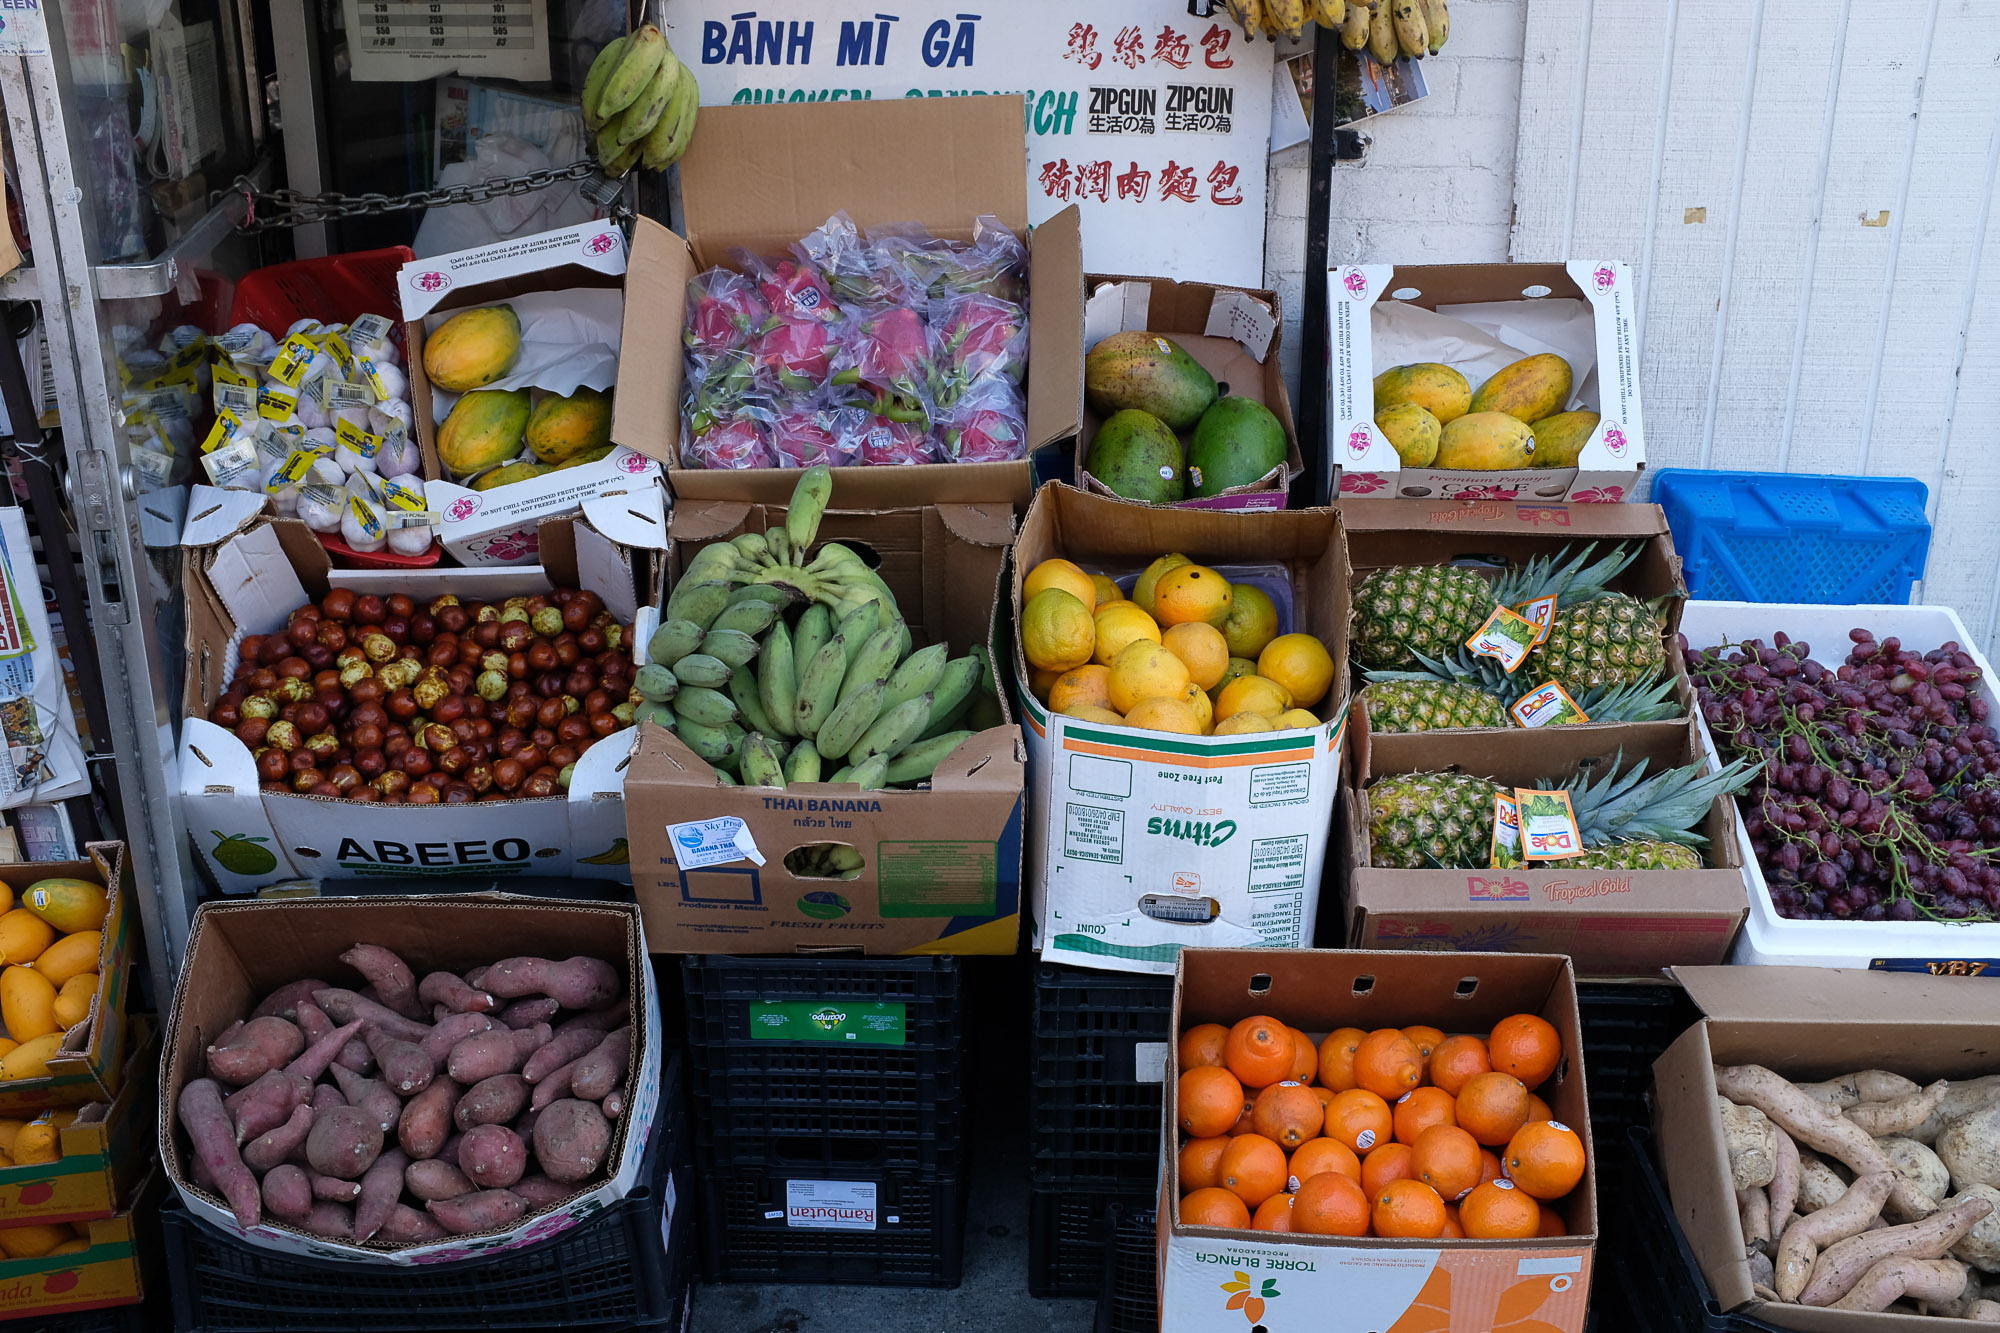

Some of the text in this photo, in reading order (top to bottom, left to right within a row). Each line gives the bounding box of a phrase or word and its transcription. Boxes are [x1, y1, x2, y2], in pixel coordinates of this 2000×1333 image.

[429, 4, 441, 13] 127
[493, 4, 505, 13] 101
[429, 15, 443, 24] 253
[492, 15, 507, 24] 202
[430, 26, 444, 35] 633
[493, 26, 508, 35] 505
[702, 11, 814, 65] BÁNH
[1089, 87, 1156, 116] ZIPGUN
[1165, 85, 1233, 115] ZIPGUN
[1089, 115, 1155, 135] 生活の為
[1165, 113, 1231, 133] 生活の為
[1627, 389, 1633, 397] DO
[1622, 416, 1627, 424] DO
[622, 457, 650, 465] COLE
[1428, 475, 1551, 484] Premium Papaya
[1441, 483, 1529, 494] COLE
[480, 483, 597, 518] DO NOT CHILL UNRIPENED FRUIT BELOW
[510, 488, 597, 516] DO NOT FREEZE AT ANY TIME.
[1429, 505, 1505, 524] Tropical Gold
[1517, 508, 1571, 527] Dole
[1520, 691, 1556, 718] Dole
[1158, 771, 1222, 785] Pest Free Zone
[762, 797, 882, 813] THAI BANANA
[1151, 804, 1193, 815] QUALITY
[793, 816, 852, 829] กล้วย ไทย
[1107, 812, 1120, 821] EMP.
[704, 821, 722, 833] Sky
[1147, 817, 1237, 847] Citrus
[691, 842, 736, 854] BANANA THAI
[1290, 844, 1303, 853] EMP.
[1531, 834, 1572, 851] Dole
[336, 837, 530, 866] ABEEO
[1468, 876, 1631, 904] Dole Tropical Gold
[678, 901, 716, 910] Produce
[734, 904, 769, 912] Mexico
[1273, 901, 1292, 909] LIMES
[1252, 910, 1291, 919] TANGERINES
[770, 920, 822, 930] FRESH
[827, 921, 887, 930] FRUITS
[1251, 918, 1291, 927] GRAPEFRUIT
[1076, 923, 1106, 935] COUNT
[1258, 926, 1291, 934] MINNEOLA
[811, 1012, 846, 1021] Ocampo
[790, 1207, 874, 1222] Rambutan
[1226, 1247, 1288, 1257] PROCESADORA
[1196, 1252, 1316, 1272] TORRE BLANCA
